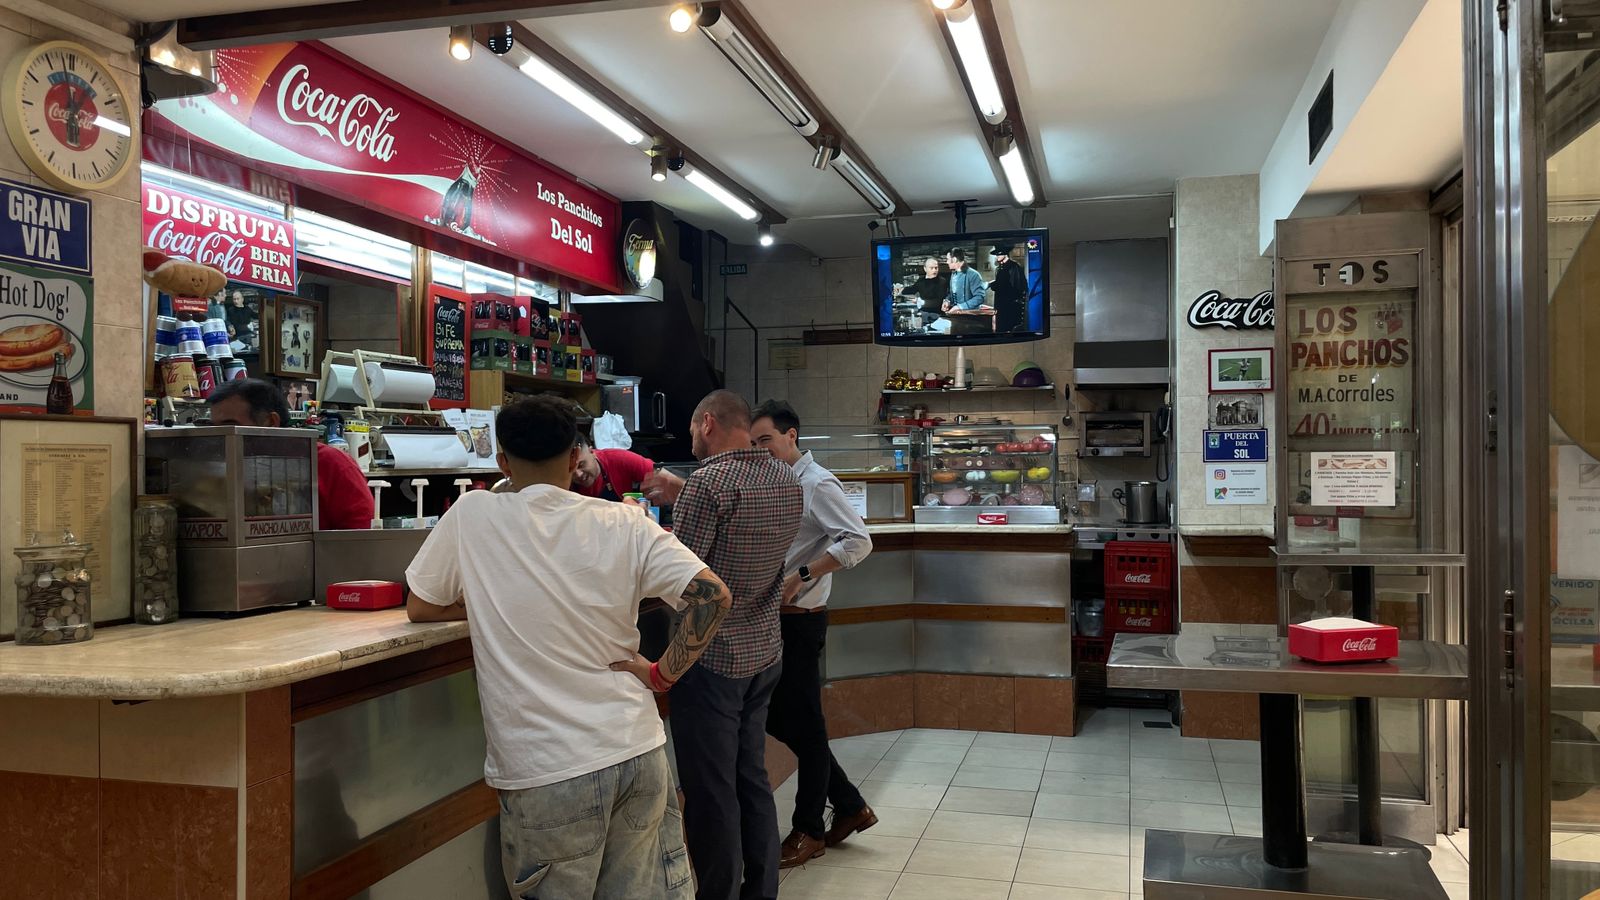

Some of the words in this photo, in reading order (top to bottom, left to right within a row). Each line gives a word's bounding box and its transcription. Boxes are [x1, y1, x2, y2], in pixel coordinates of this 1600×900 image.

[277, 64, 400, 162] Coca-Cola
[9, 190, 71, 232] GRAN
[146, 188, 291, 247] DISFRUTA
[537, 181, 556, 206] Los
[557, 192, 603, 227] Panchitos
[22, 224, 61, 261] VIA
[147, 219, 247, 276] Coca-Cola
[551, 217, 573, 246] Del
[575, 228, 593, 254] Sol
[250, 245, 291, 268] BIEN
[251, 264, 292, 287] FRIA
[0, 275, 28, 307] Hot
[33, 280, 69, 321] Dog!
[1298, 306, 1358, 337] LOS
[1291, 338, 1410, 371] PANCHOS
[1338, 374, 1358, 383] DE
[1224, 432, 1260, 440] PUERTA
[1233, 448, 1250, 459] SOL
[183, 523, 223, 539] VAPOR
[250, 522, 279, 538] PANCHO
[280, 521, 289, 536] AL
[289, 519, 311, 535] VAPOR
[1124, 572, 1151, 584] Coca-Cola
[338, 592, 361, 602] Coca-Cola
[1342, 637, 1378, 653] Coca-Cola
